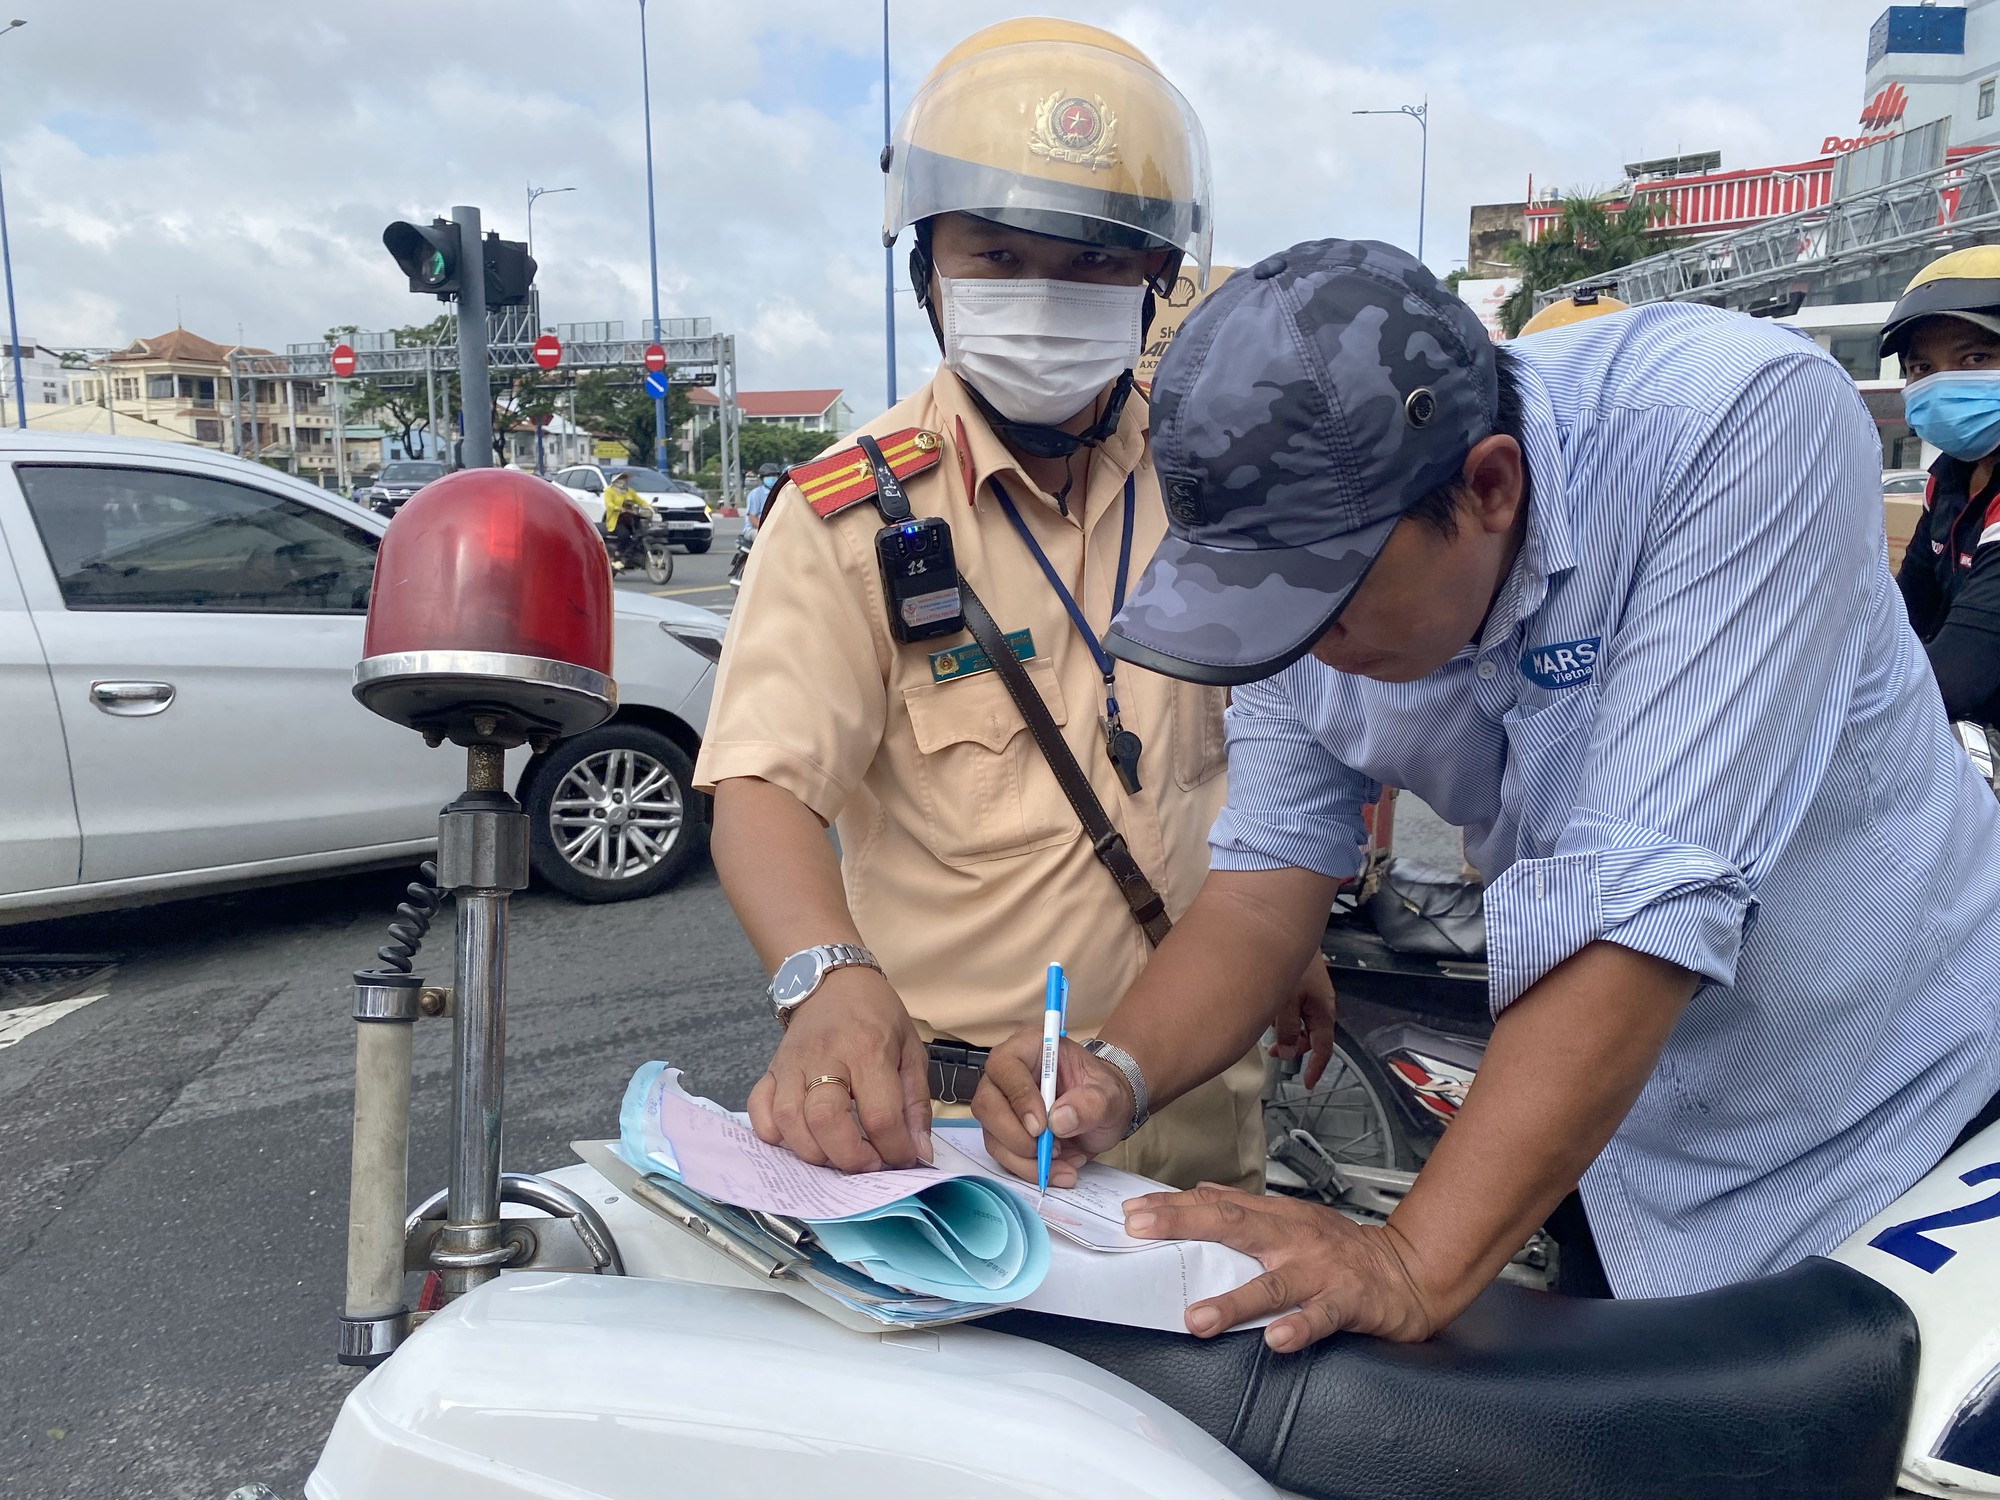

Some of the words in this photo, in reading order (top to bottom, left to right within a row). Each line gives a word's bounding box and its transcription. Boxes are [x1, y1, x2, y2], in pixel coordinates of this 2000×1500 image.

[1160, 326, 1175, 338] Sh
[1532, 643, 1597, 674] MARS
[1552, 666, 1593, 684] Vietna
